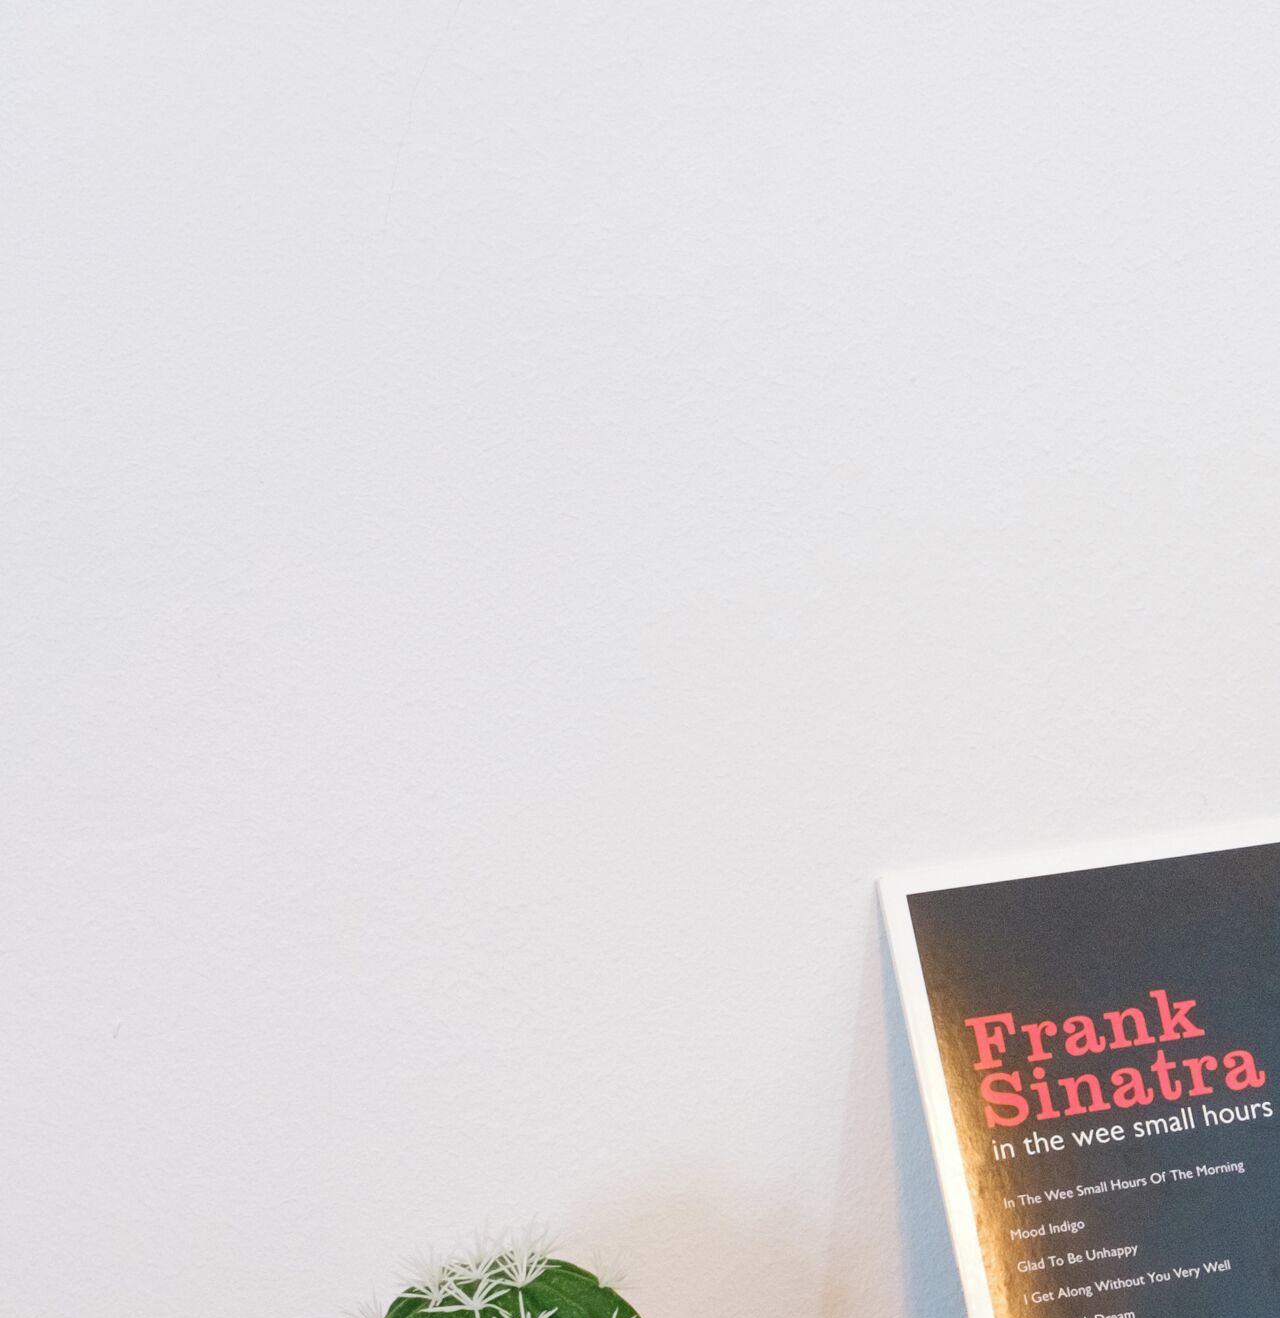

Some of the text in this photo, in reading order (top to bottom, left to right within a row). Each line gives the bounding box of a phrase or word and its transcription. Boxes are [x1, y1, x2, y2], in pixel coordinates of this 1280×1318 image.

[965, 989, 1206, 1071] Frank
[980, 1049, 1266, 1128] Sinatra
[992, 1102, 1273, 1160] in the wee small hours
[1004, 1162, 1245, 1208] In The Wee Small Hours Of The Morning
[1010, 1221, 1085, 1240] Mood Indigo
[1017, 1245, 1137, 1272] Glad To Be Unhappy
[1024, 1260, 1231, 1304] I Get Along Without You Very Well
